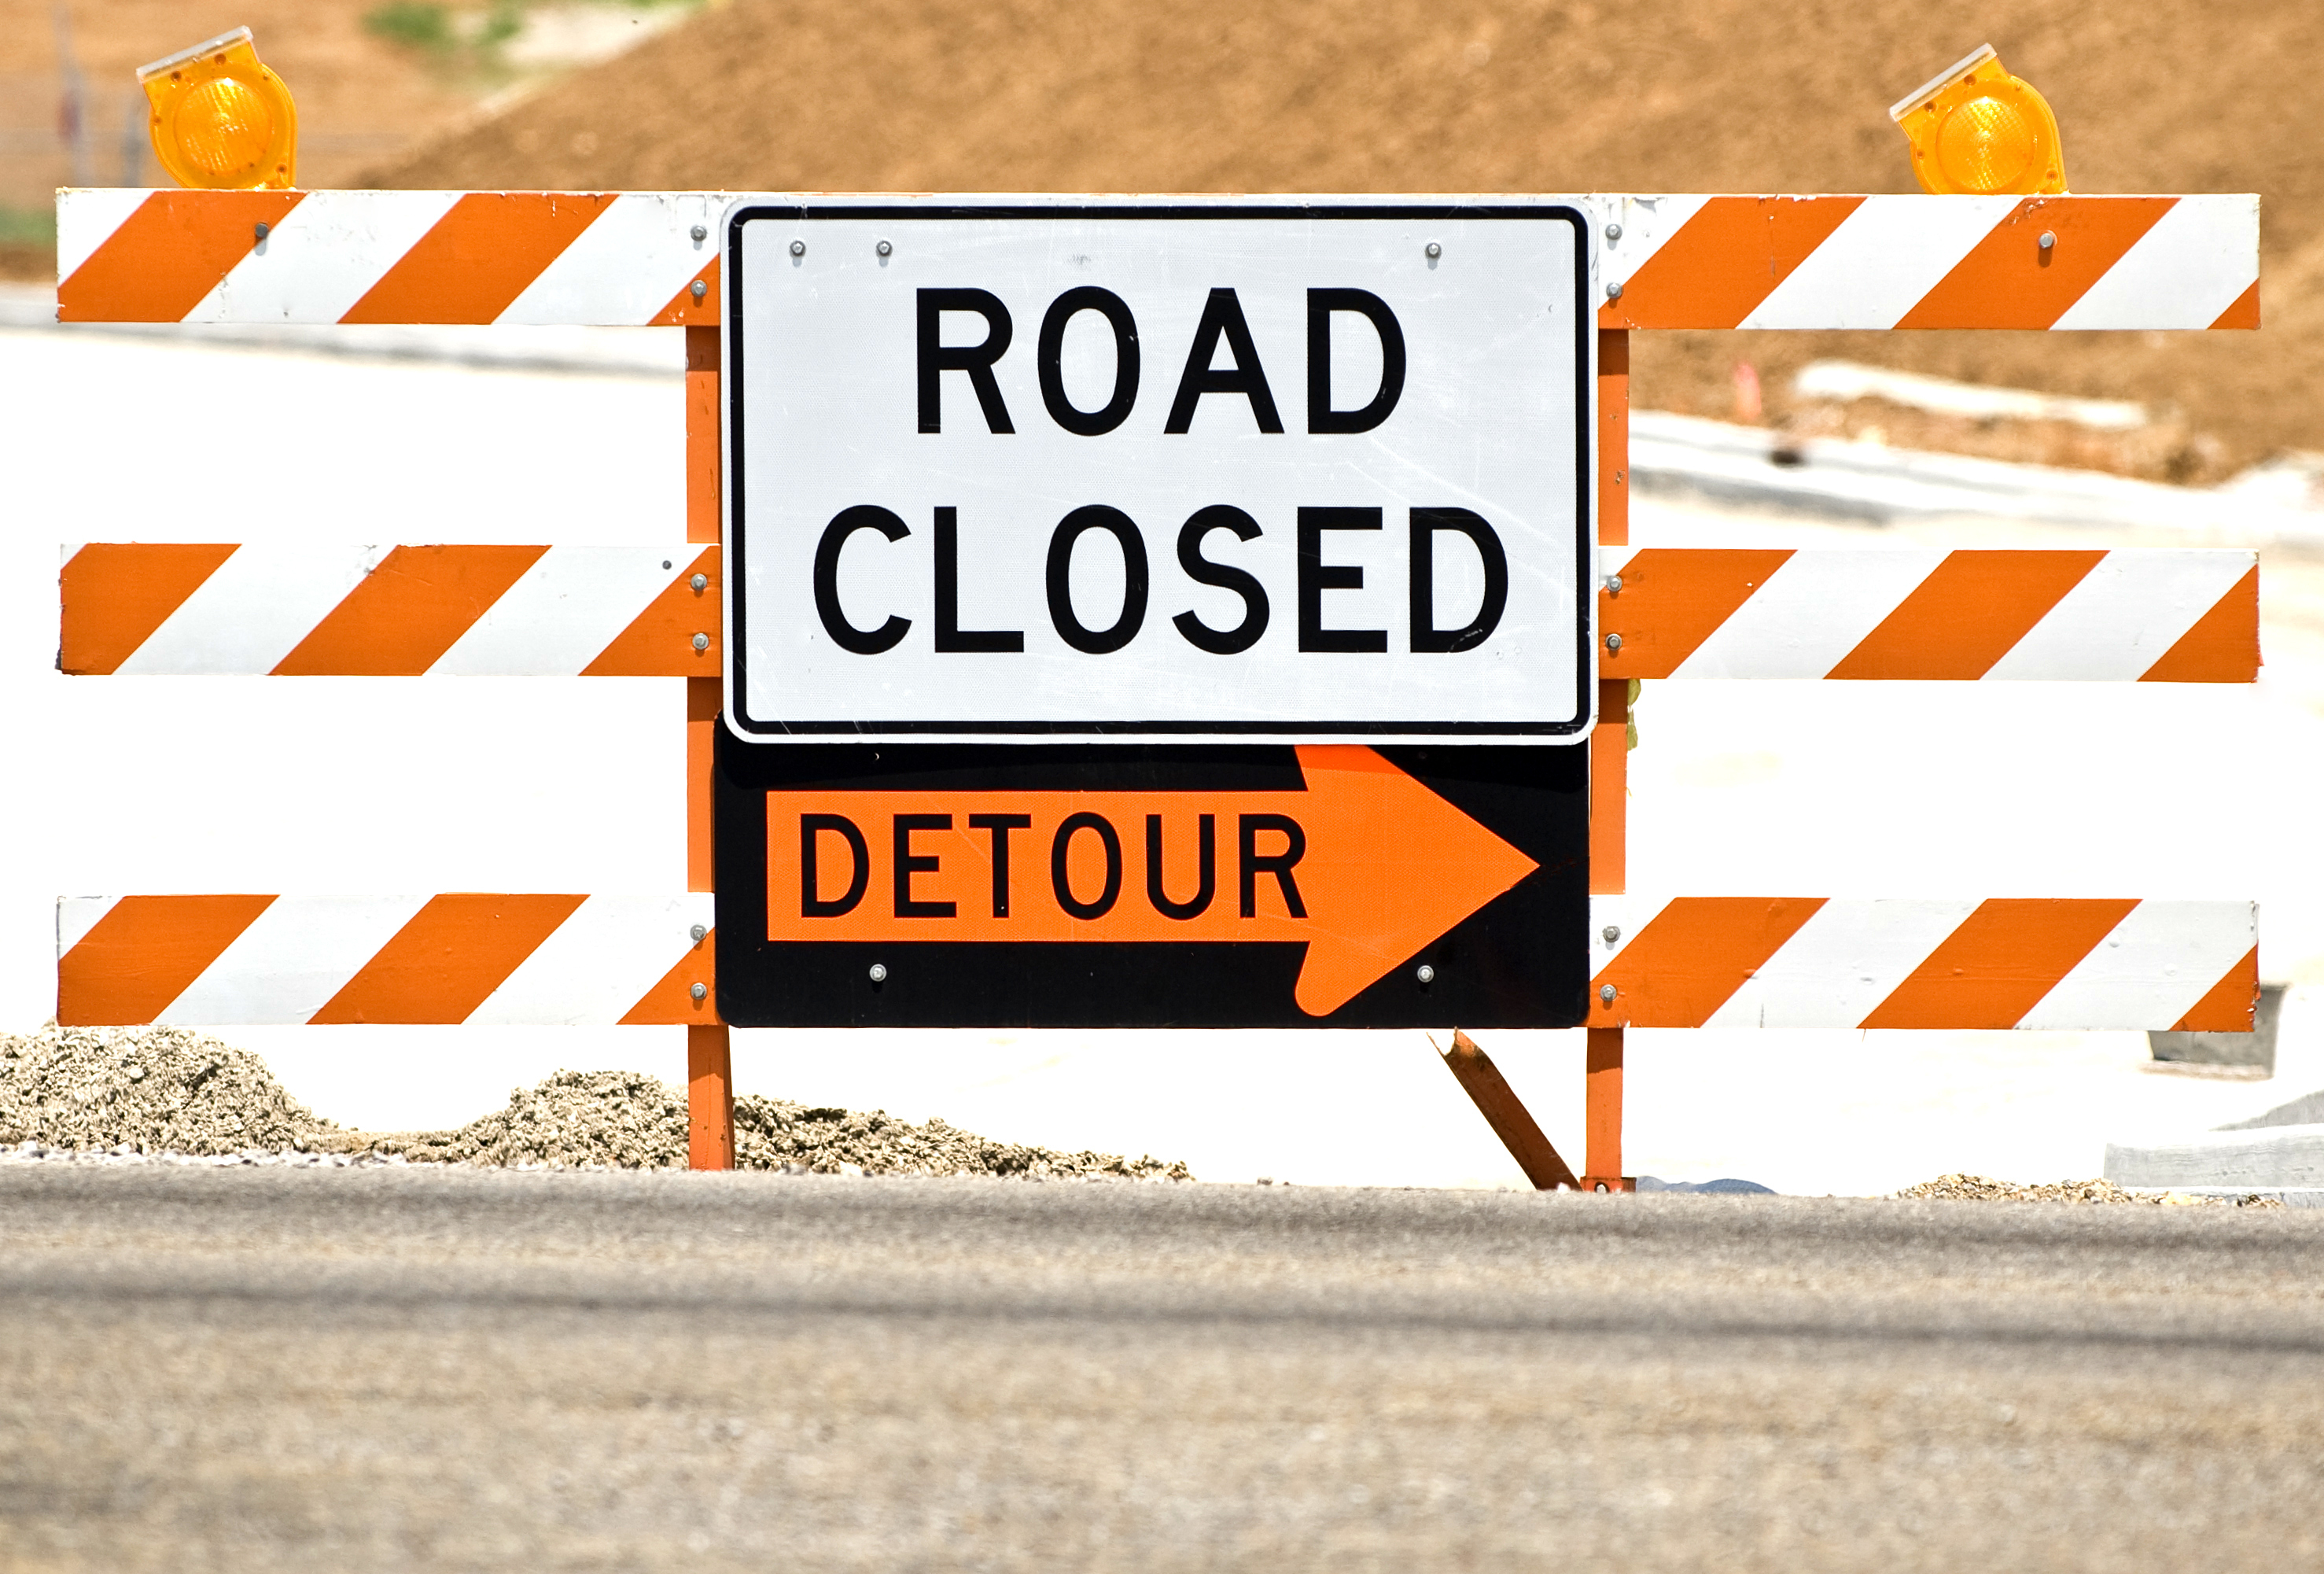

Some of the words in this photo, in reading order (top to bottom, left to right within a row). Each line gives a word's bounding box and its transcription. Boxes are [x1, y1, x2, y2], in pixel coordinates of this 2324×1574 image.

[917, 286, 1405, 437] ROAD
[814, 504, 1508, 655] CLOSED
[801, 813, 1307, 920] DETOUR
